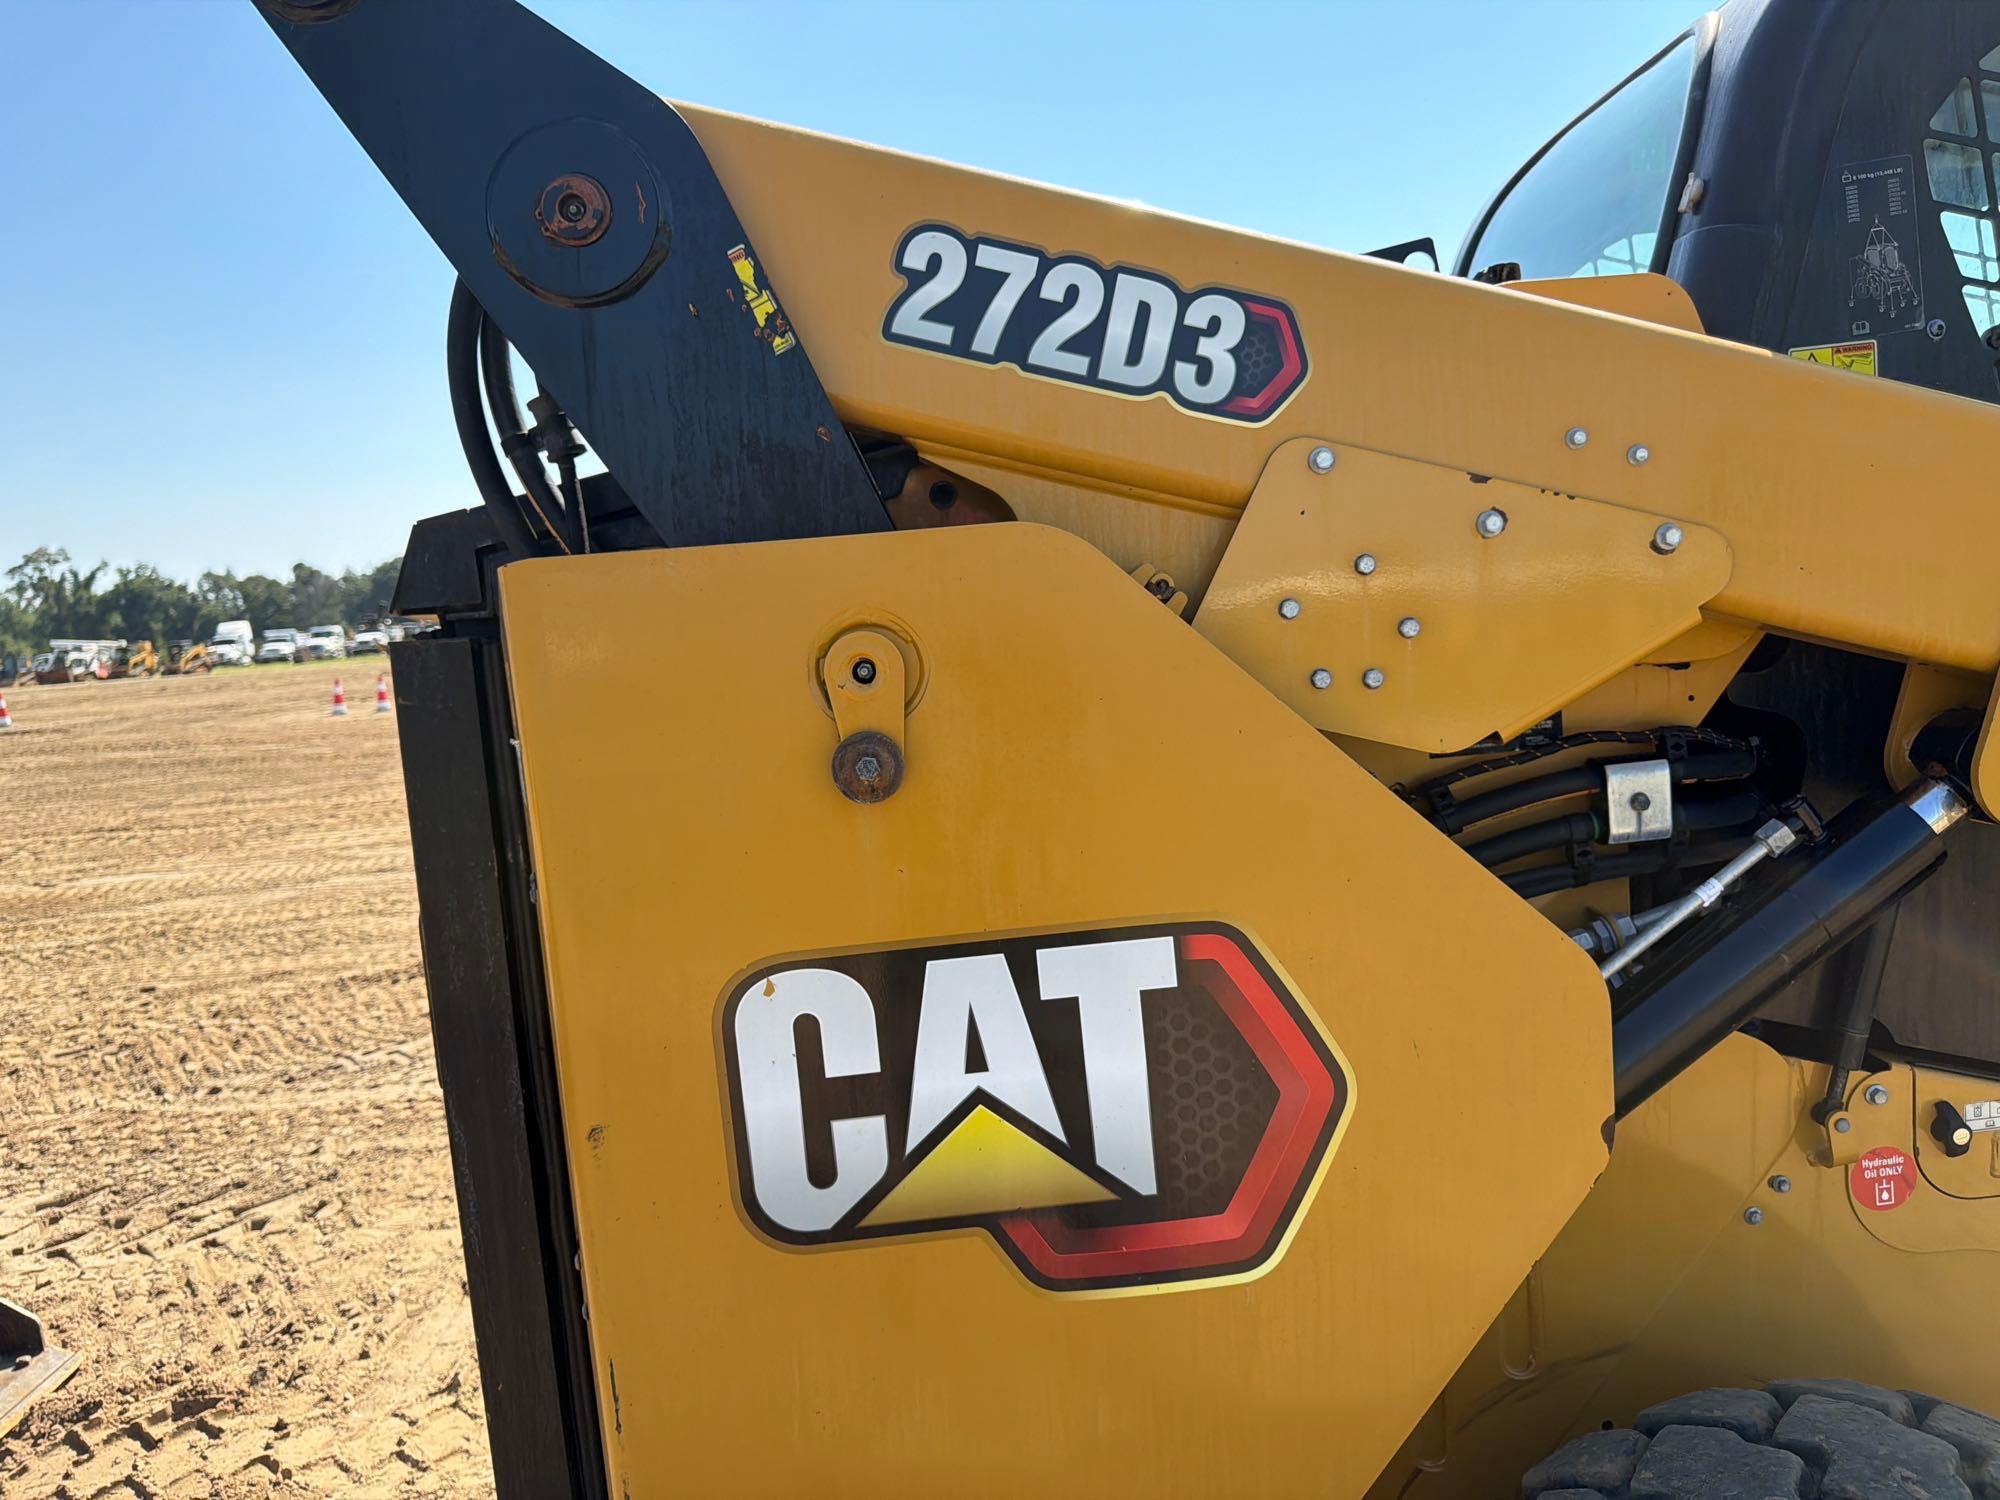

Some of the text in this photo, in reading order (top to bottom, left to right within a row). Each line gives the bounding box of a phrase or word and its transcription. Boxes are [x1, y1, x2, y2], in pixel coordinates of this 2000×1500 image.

[891, 231, 1246, 404] 272D3
[1842, 343, 1873, 353] WARNING
[734, 936, 1178, 1232] CAT
[1861, 1155, 1905, 1170] Hydraulic
[1864, 1165, 1903, 1179] Oil ONLY
